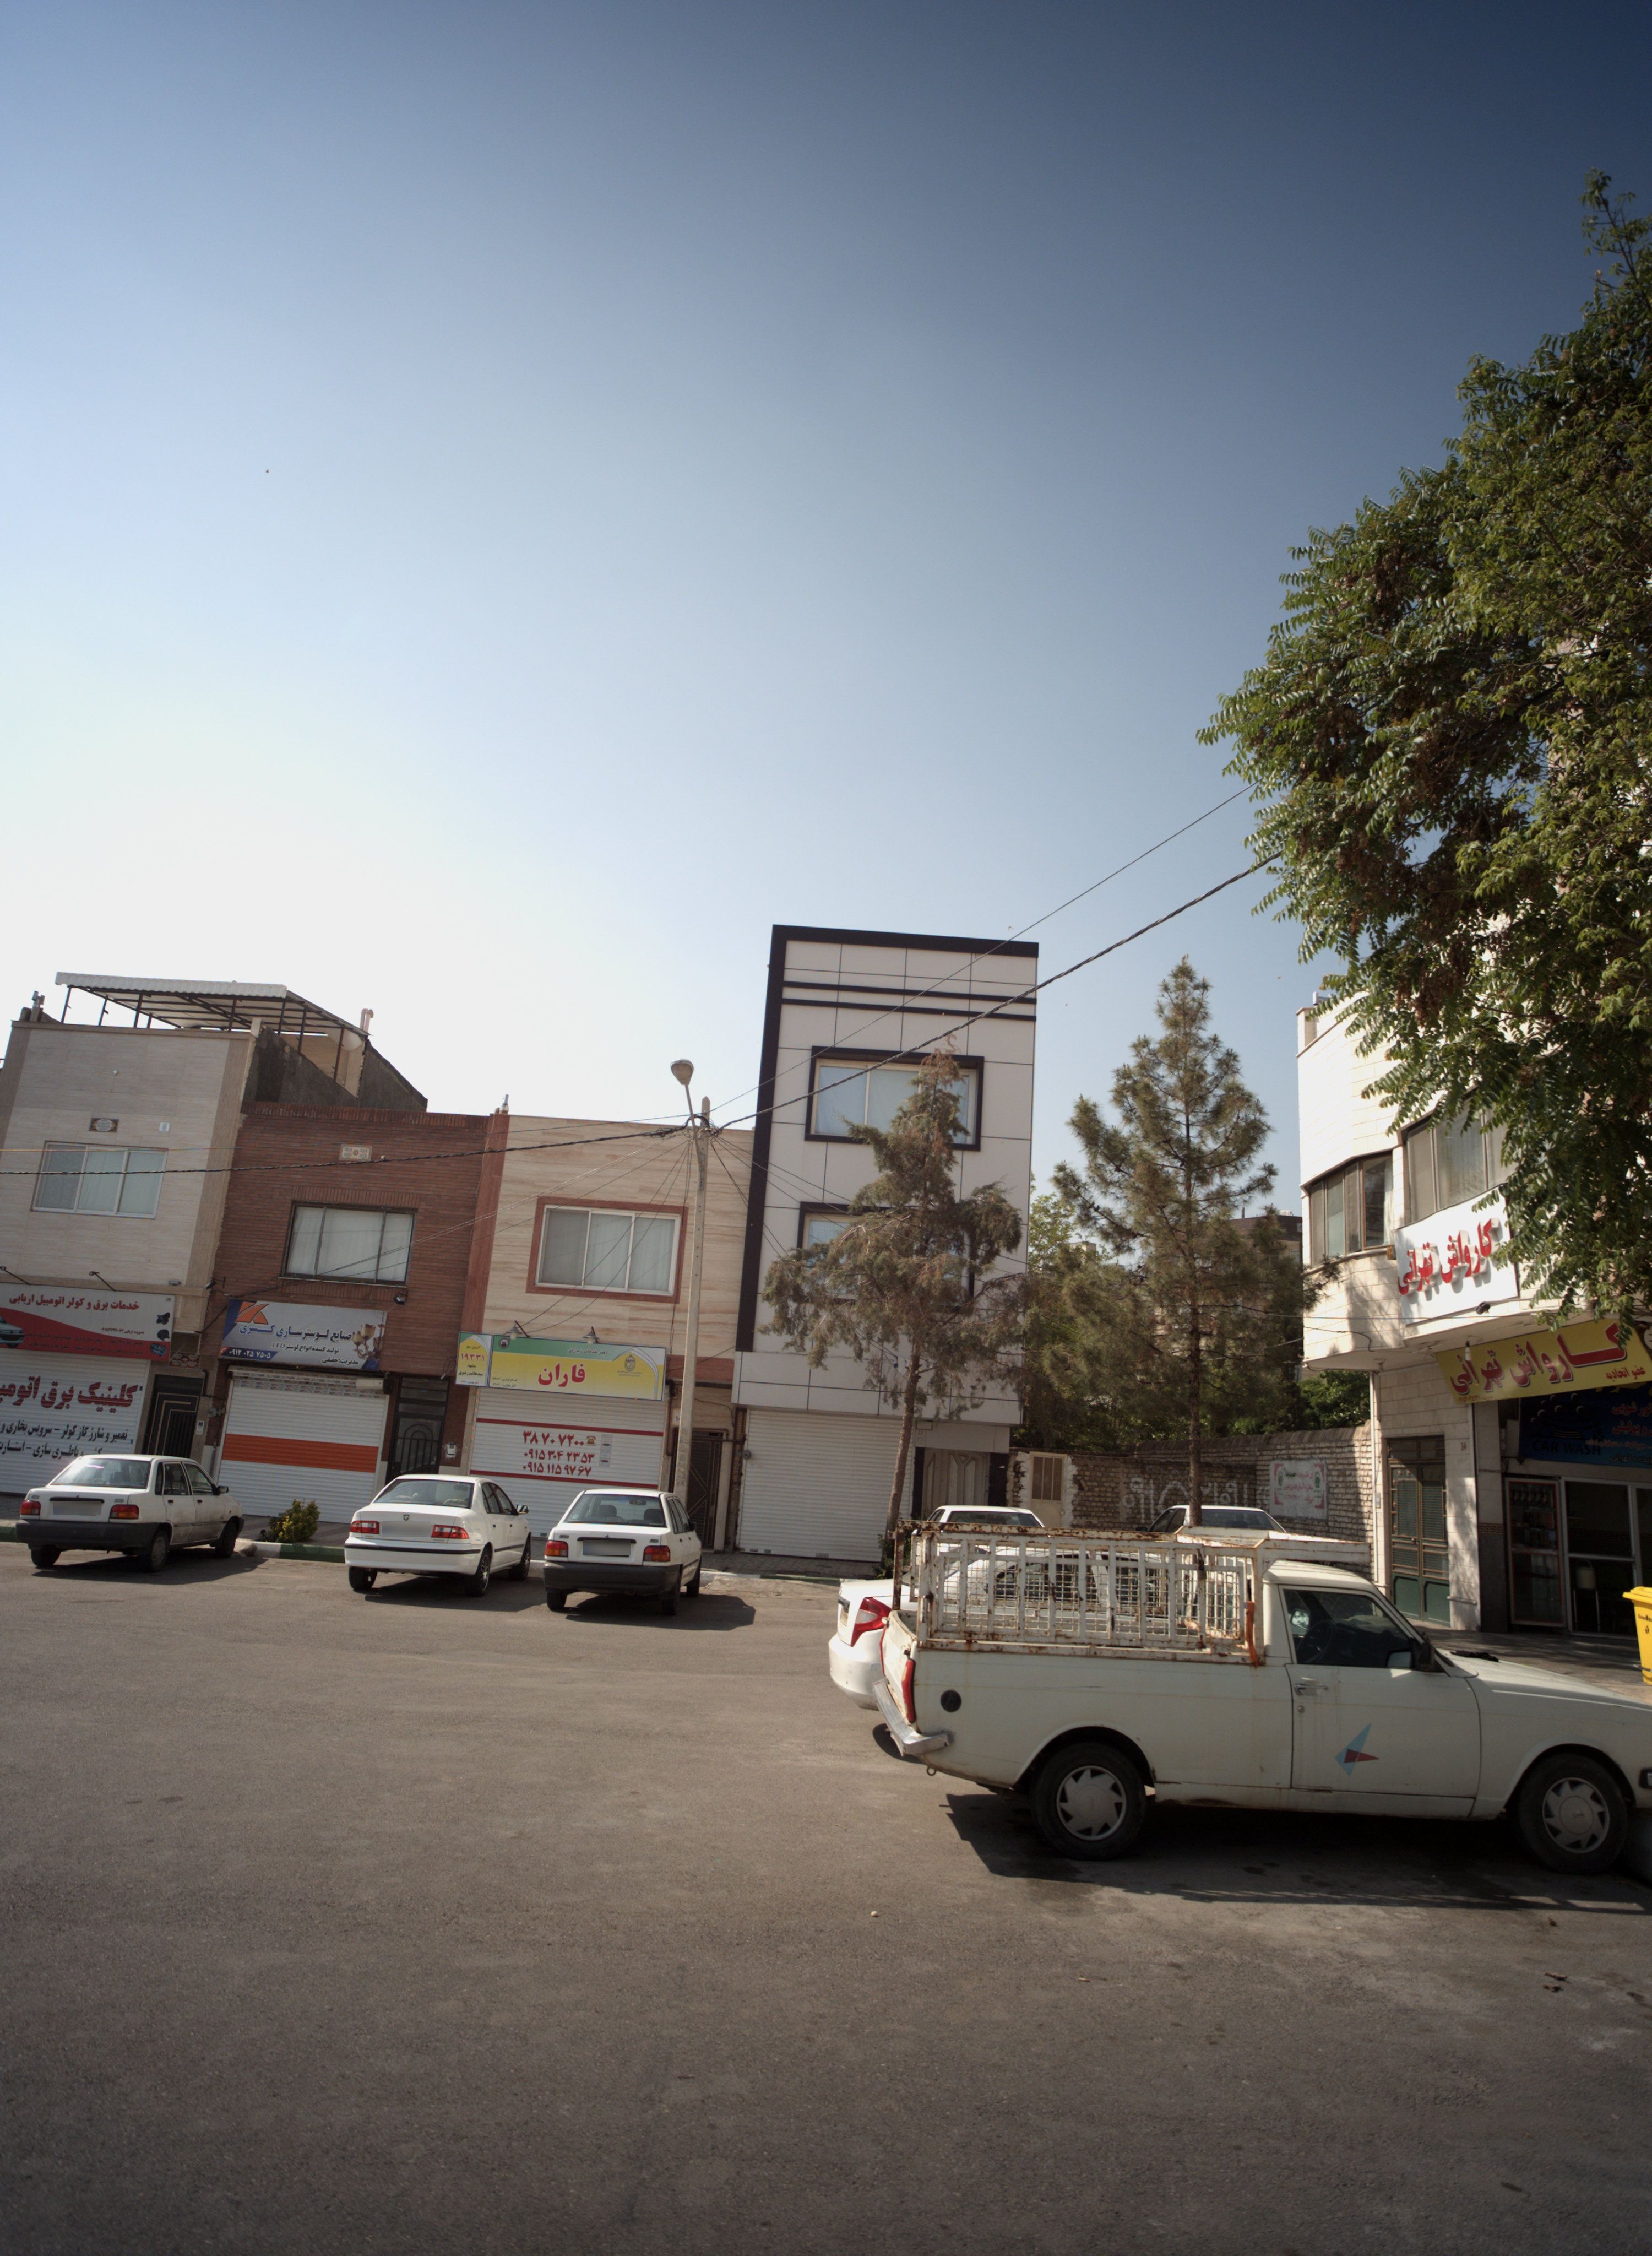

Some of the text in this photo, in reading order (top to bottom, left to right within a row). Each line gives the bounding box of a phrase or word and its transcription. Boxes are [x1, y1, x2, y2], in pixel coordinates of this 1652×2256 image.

[1398, 1218, 1493, 1295] کارواش تهرانی
[8, 1293, 140, 1311] خدمات برق و کولر اتومبیل اربابی
[239, 1324, 275, 1336] کسری
[330, 1330, 352, 1342] صنایع
[1449, 1322, 1627, 1395] کارواش تهرانی
[537, 1362, 586, 1387] فاران
[1605, 1365, 1646, 1382] عضو اتحادیه
[0, 1375, 138, 1413] کلینیک برق اتومب
[6, 1419, 28, 1435] بخاری
[28, 1424, 53, 1438] سرویس
[61, 1423, 78, 1440] کولر
[105, 1433, 110, 1443] و
[110, 1429, 128, 1444] تعمیر
[32, 1442, 51, 1459] سازی
[524, 1448, 546, 1460] ۰۹۱۵
[1532, 1439, 1559, 1453] CAR
[1563, 1442, 1601, 1456] WASH
[522, 1461, 544, 1473] ۰۹۱۵
